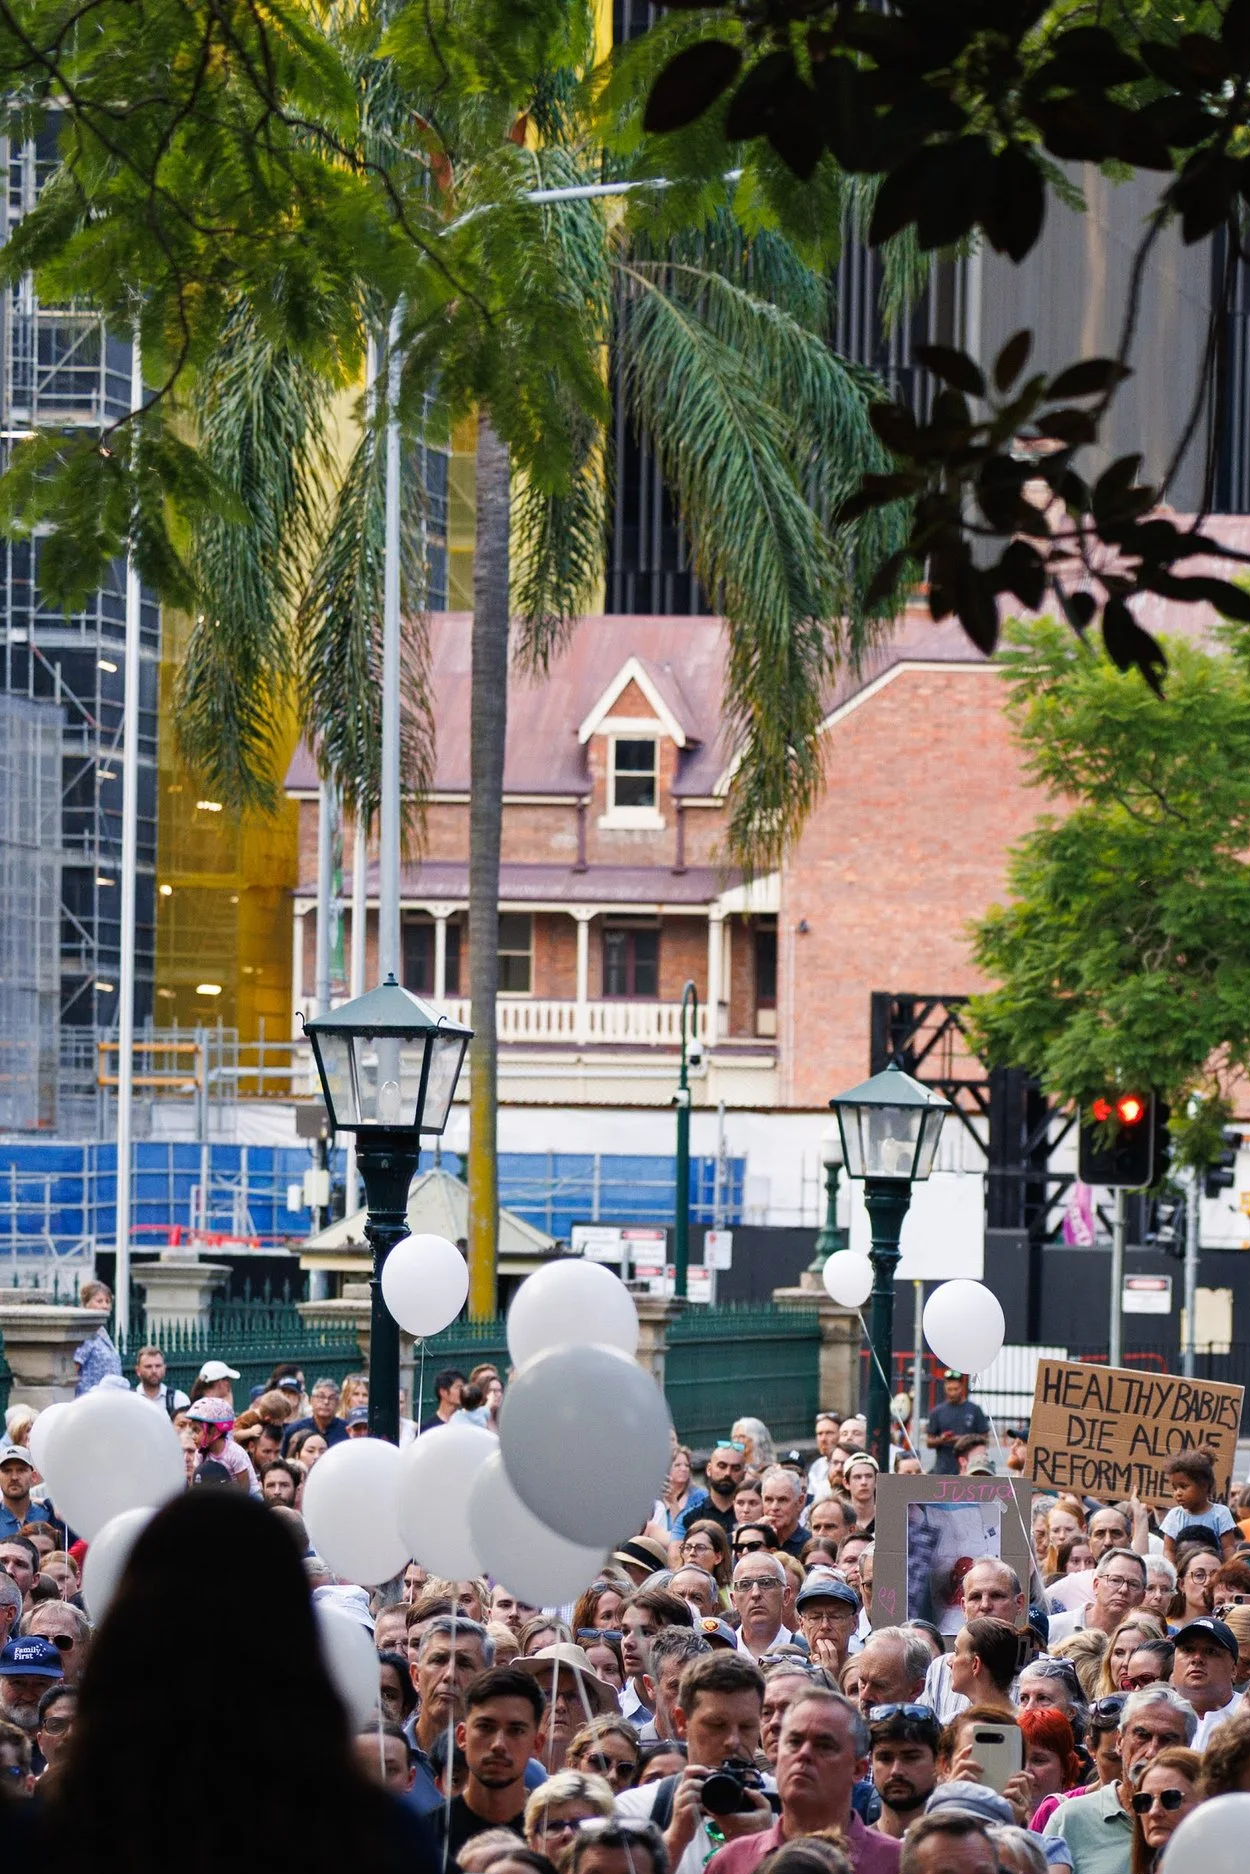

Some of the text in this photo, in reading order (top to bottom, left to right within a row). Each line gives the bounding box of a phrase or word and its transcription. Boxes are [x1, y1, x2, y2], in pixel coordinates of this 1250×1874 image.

[1043, 1367, 1240, 1430] HEALTHY BABIES
[1067, 1414, 1223, 1457] DIE ALONE
[1032, 1446, 1133, 1493] REFORM
[1133, 1462, 1174, 1498] THE
[15, 1646, 41, 1655] Family
